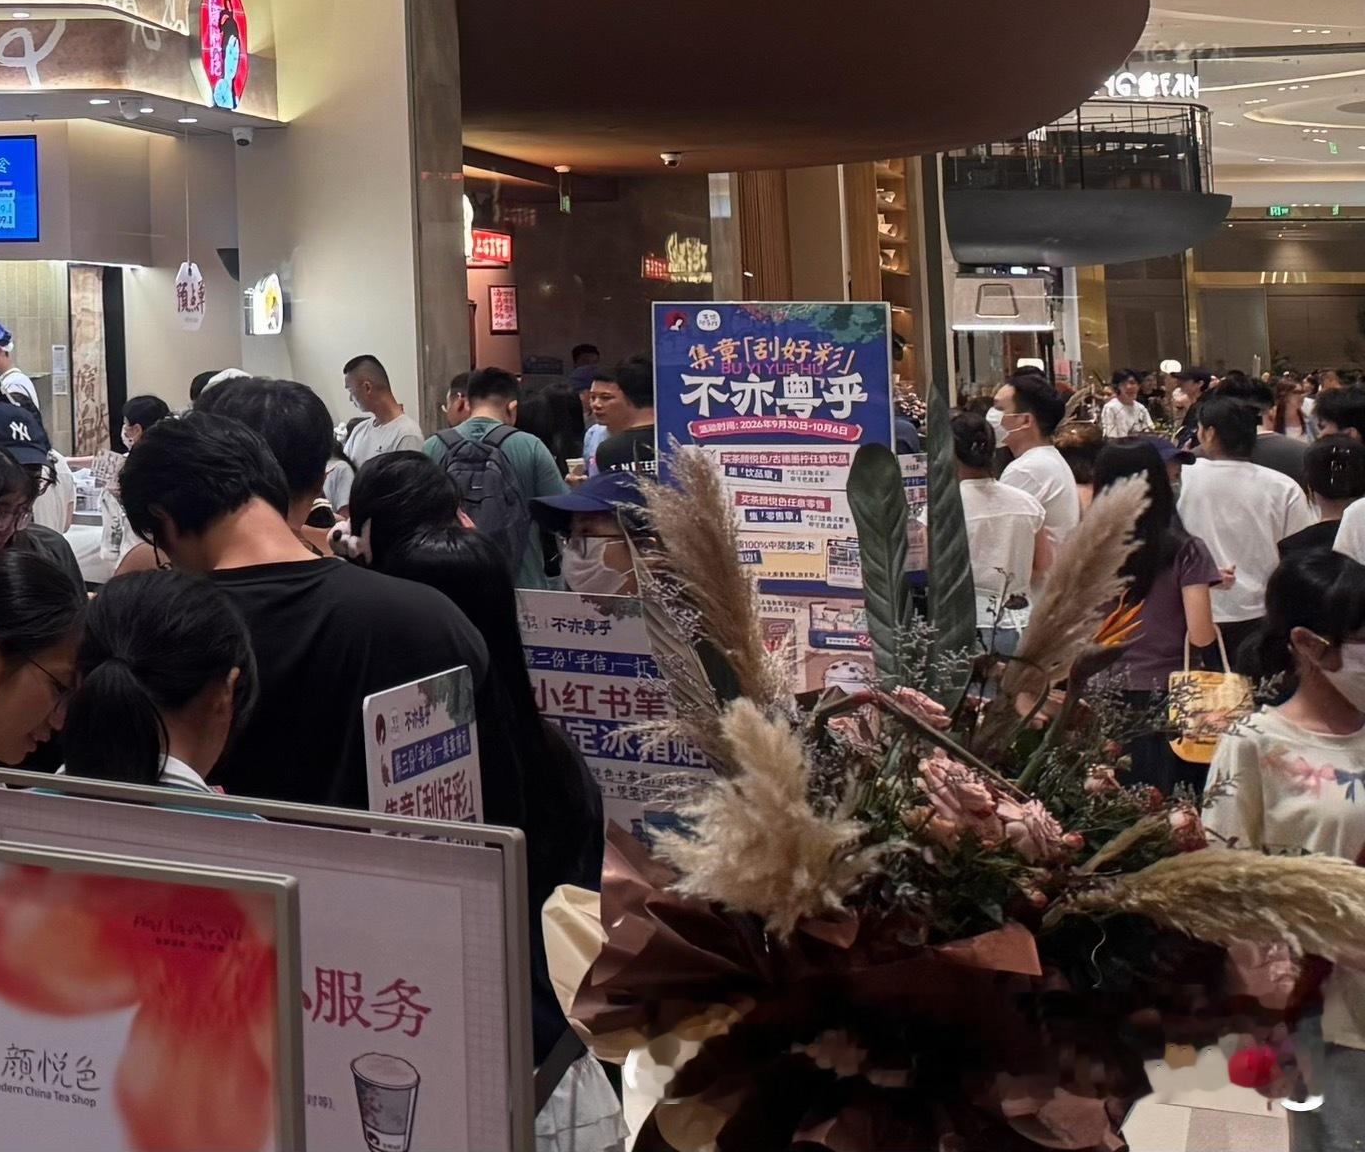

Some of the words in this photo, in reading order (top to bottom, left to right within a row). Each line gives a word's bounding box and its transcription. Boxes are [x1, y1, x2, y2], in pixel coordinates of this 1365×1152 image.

[721, 362, 743, 375] BU
[748, 362, 761, 375] YI
[765, 362, 795, 376] YUE
[800, 362, 825, 376] HU
[9, 421, 31, 441] NY
[551, 617, 612, 636] 不亦粤乎
[302, 966, 432, 1038] 服务
[25, 1086, 52, 1101] China
[53, 1090, 71, 1104] Tea
[71, 1094, 97, 1109] Shop
